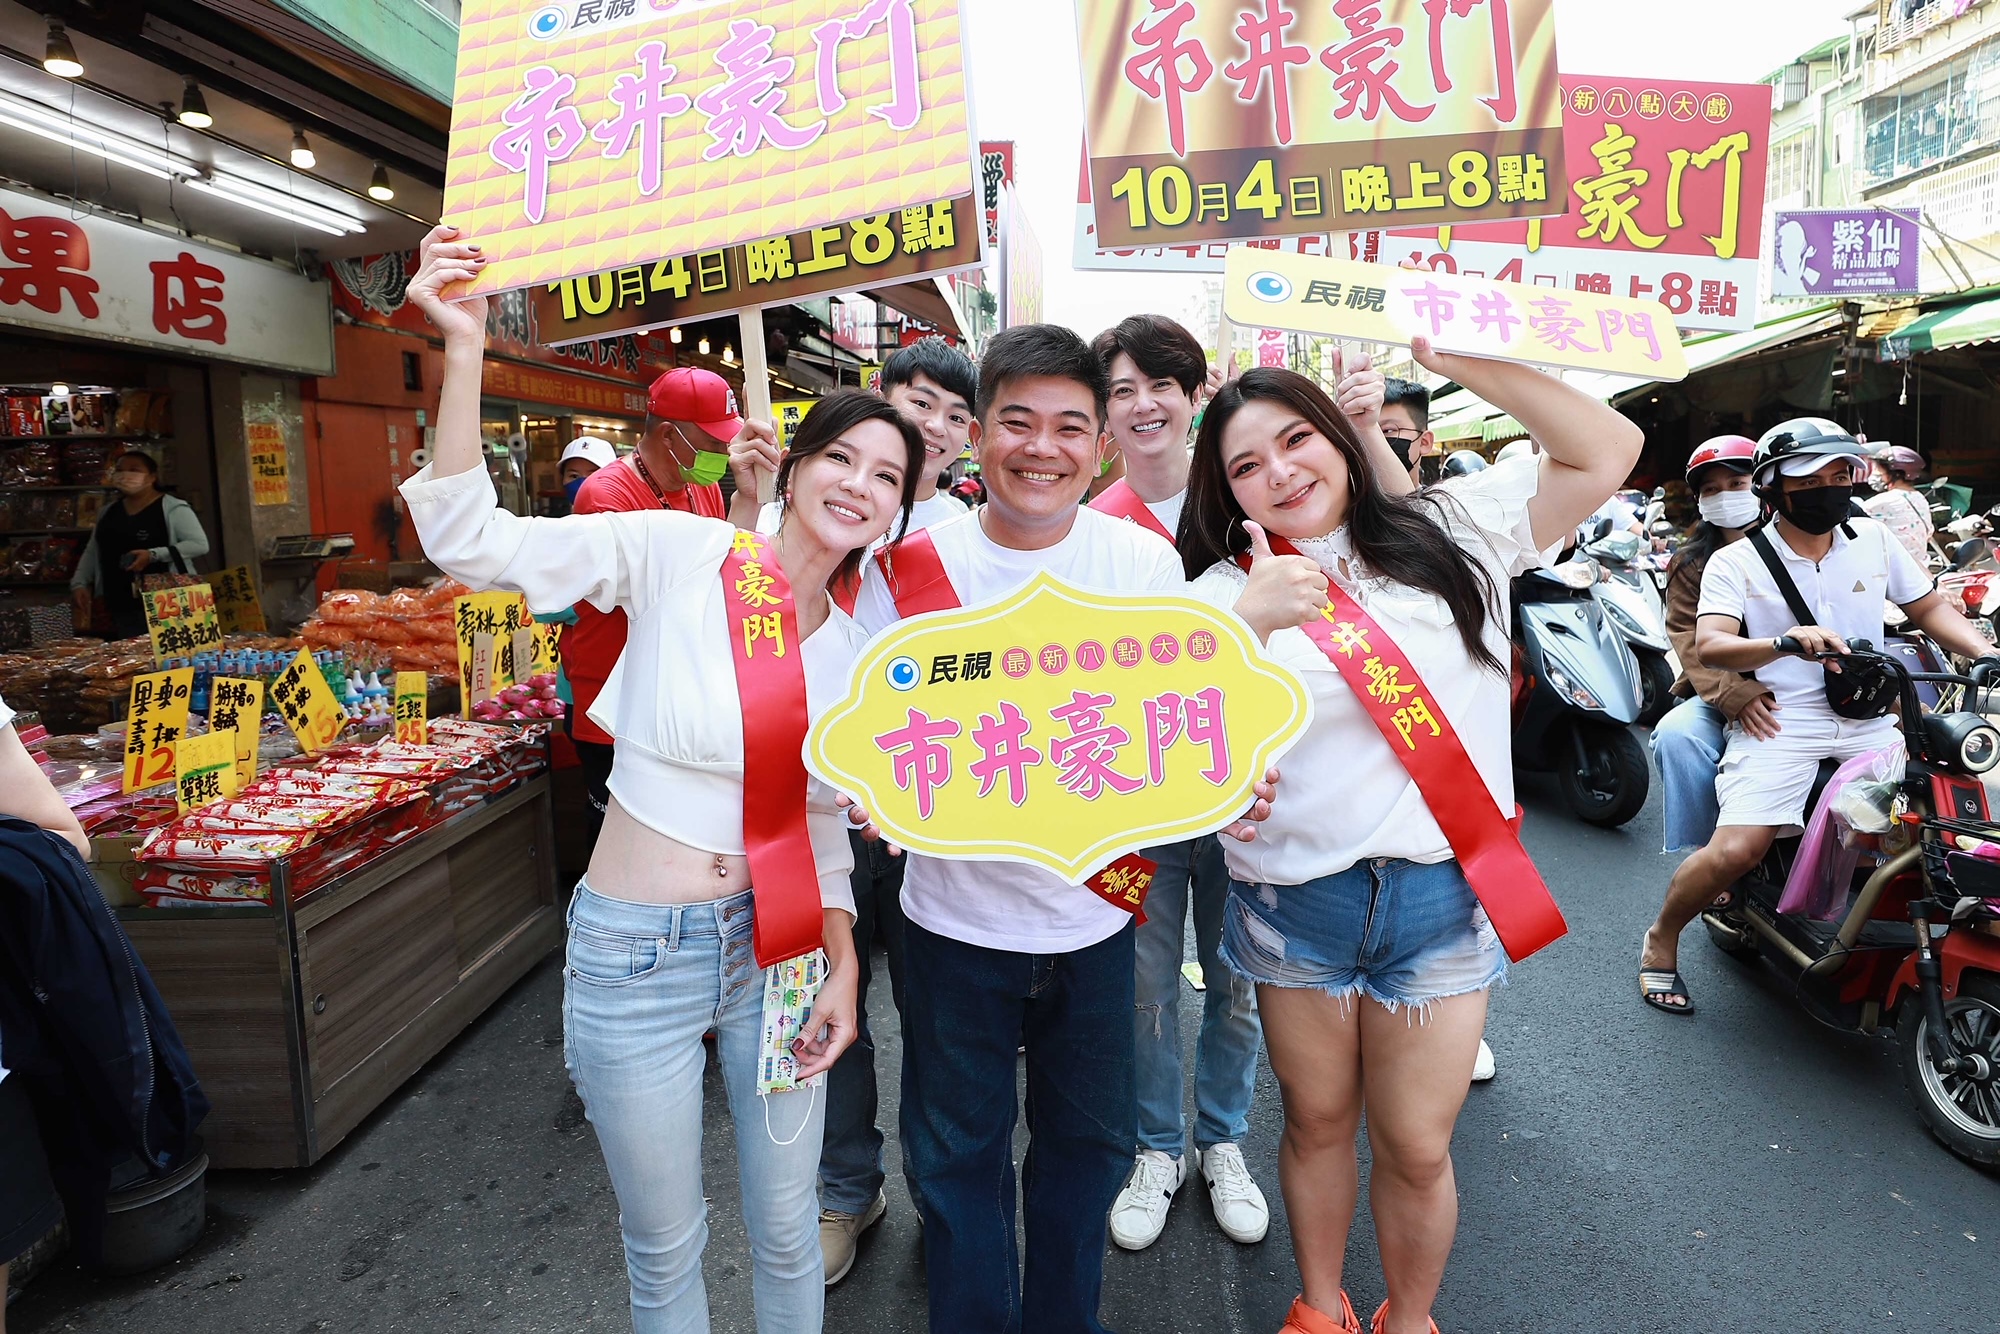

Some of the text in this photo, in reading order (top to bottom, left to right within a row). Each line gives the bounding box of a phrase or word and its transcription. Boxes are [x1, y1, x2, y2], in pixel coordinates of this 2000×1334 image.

[571, 0, 637, 29] 民視
[1124, 0, 1517, 157] 市井豪門
[490, 0, 922, 223] 市井豪門
[1111, 150, 1548, 229] 10月4日 晚上8點
[1832, 219, 1900, 253] 紫仙
[1832, 251, 1900, 270] 精品服飾
[1301, 280, 1387, 313] 民視
[1400, 280, 1663, 362] 市井豪門
[154, 592, 181, 620] 25
[927, 630, 1218, 686] 民視 最新八點大戲
[397, 720, 422, 745] 25
[873, 686, 1234, 820] 市井豪門
